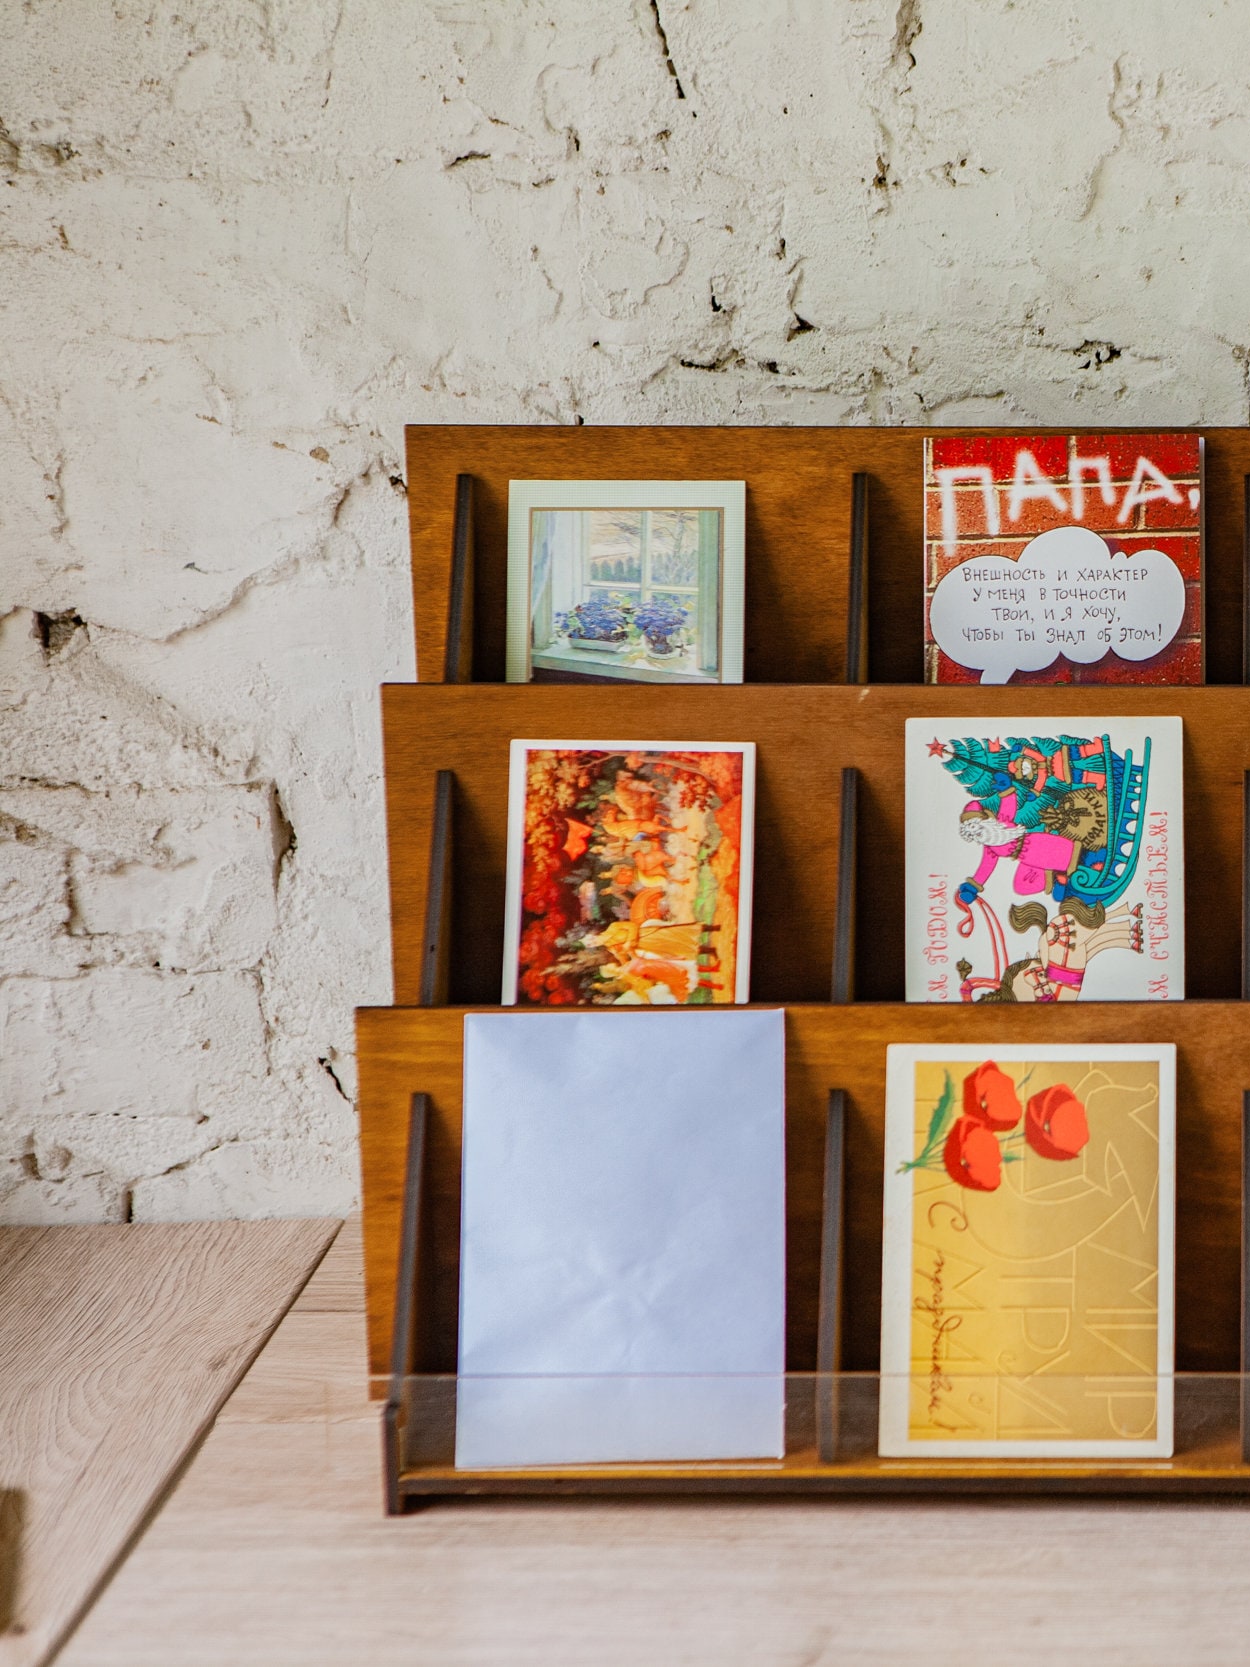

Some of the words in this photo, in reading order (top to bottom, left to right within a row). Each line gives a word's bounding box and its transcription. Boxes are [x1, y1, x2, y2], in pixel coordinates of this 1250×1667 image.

[934, 450, 1200, 557] ПАПА,
[962, 567, 1046, 582] ВНЕШНОСТЬ
[1057, 569, 1068, 581] И
[1077, 567, 1149, 582] ХАРАКТЕР
[973, 587, 982, 602] У
[988, 587, 1026, 604] МЕНЯ
[1040, 587, 1047, 600] В
[1052, 587, 1127, 601] ТОЧНОСТИ
[1044, 608, 1055, 621] И
[1060, 606, 1072, 622] Я
[1082, 605, 1121, 625] ХОЧУ,
[962, 627, 1004, 642] ЧТОБЫ
[1016, 628, 1036, 642] ТЫ
[1046, 627, 1086, 645] ЗНАЛ
[1119, 623, 1163, 643] ЭТОМ!
